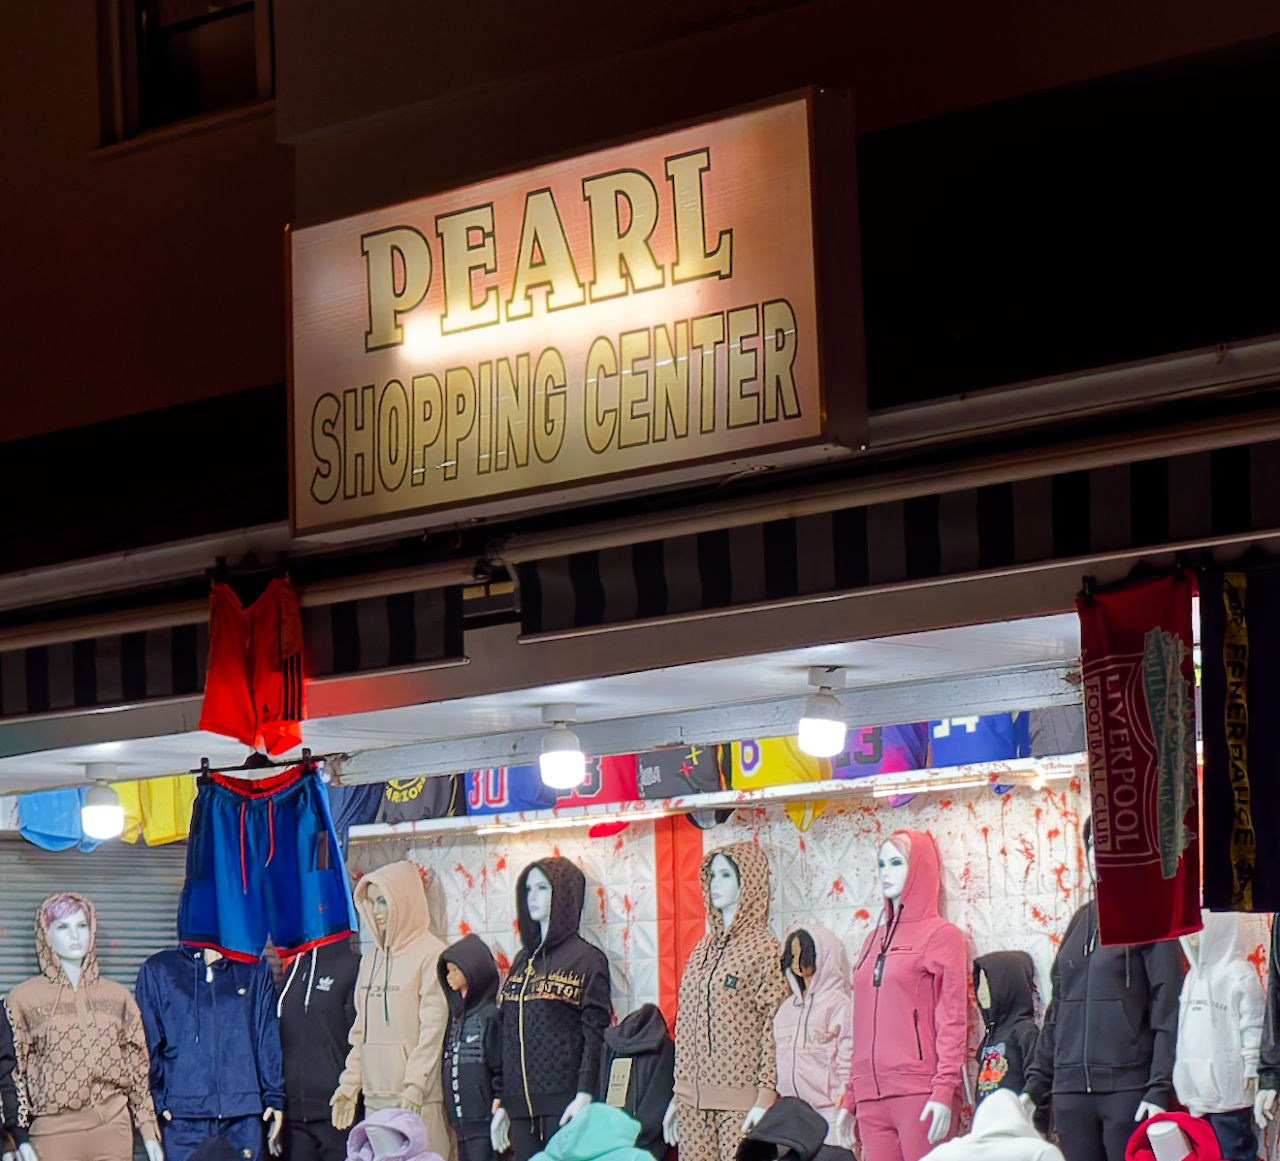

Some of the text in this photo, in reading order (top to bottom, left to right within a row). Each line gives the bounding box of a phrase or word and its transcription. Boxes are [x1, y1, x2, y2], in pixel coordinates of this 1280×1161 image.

[360, 147, 734, 353] PEARL
[309, 298, 802, 505] SHOPPING CENTER
[1086, 683, 1110, 847] FOOTBALL CLUB
[1104, 673, 1140, 851] LIVERPOOL
